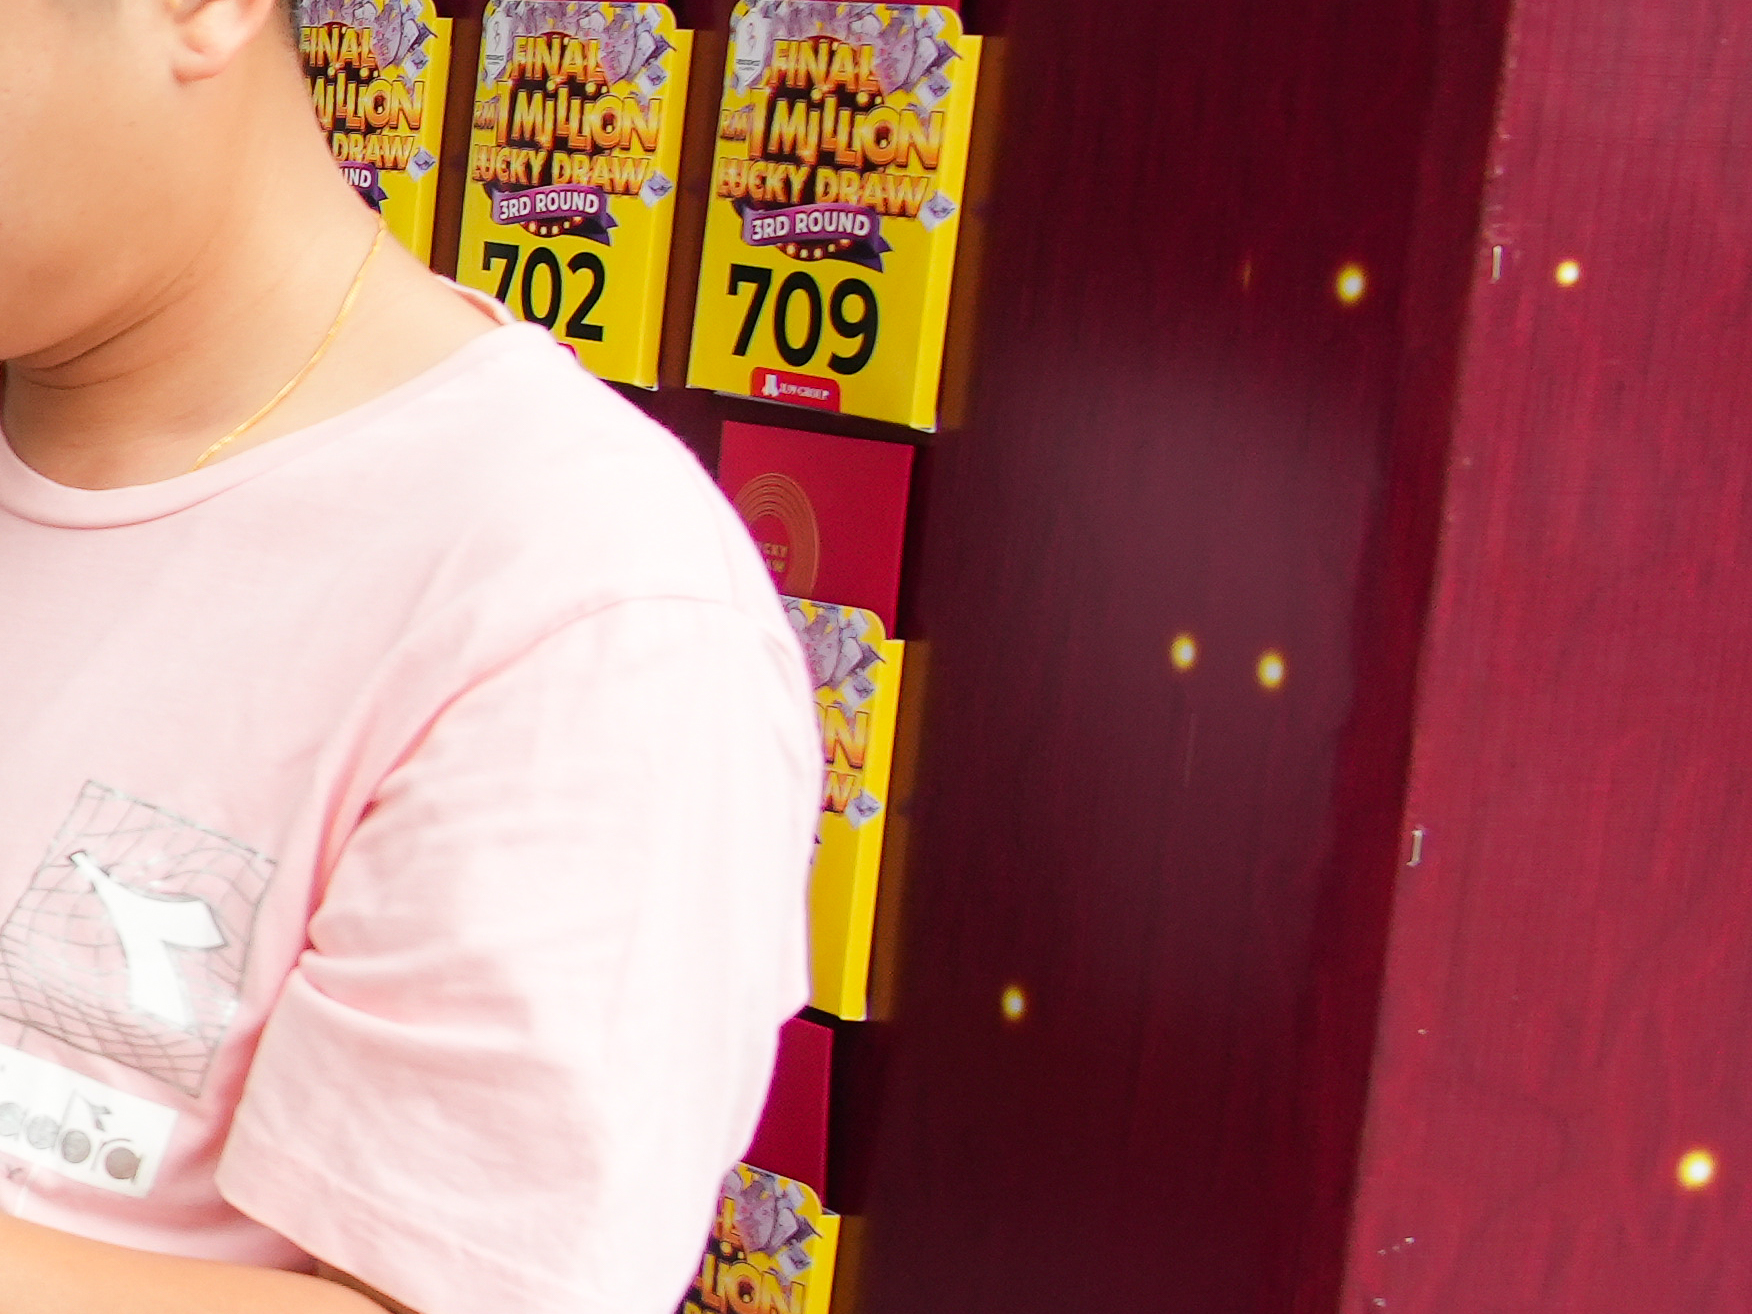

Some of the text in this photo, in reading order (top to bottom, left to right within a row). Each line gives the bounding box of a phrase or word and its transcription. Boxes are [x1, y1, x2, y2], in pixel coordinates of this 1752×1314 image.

[511, 35, 606, 84] FINAL
[769, 38, 881, 94] FINAL
[511, 81, 661, 152] MILLION
[767, 88, 945, 170] MILLION
[332, 131, 416, 171] DRAW
[552, 151, 652, 195] DRAW
[500, 191, 599, 220] 3RD ROUND
[814, 166, 931, 218] DRAW
[751, 211, 871, 240] 3RD ROUND
[482, 241, 605, 342] 702
[726, 263, 879, 375] 709
